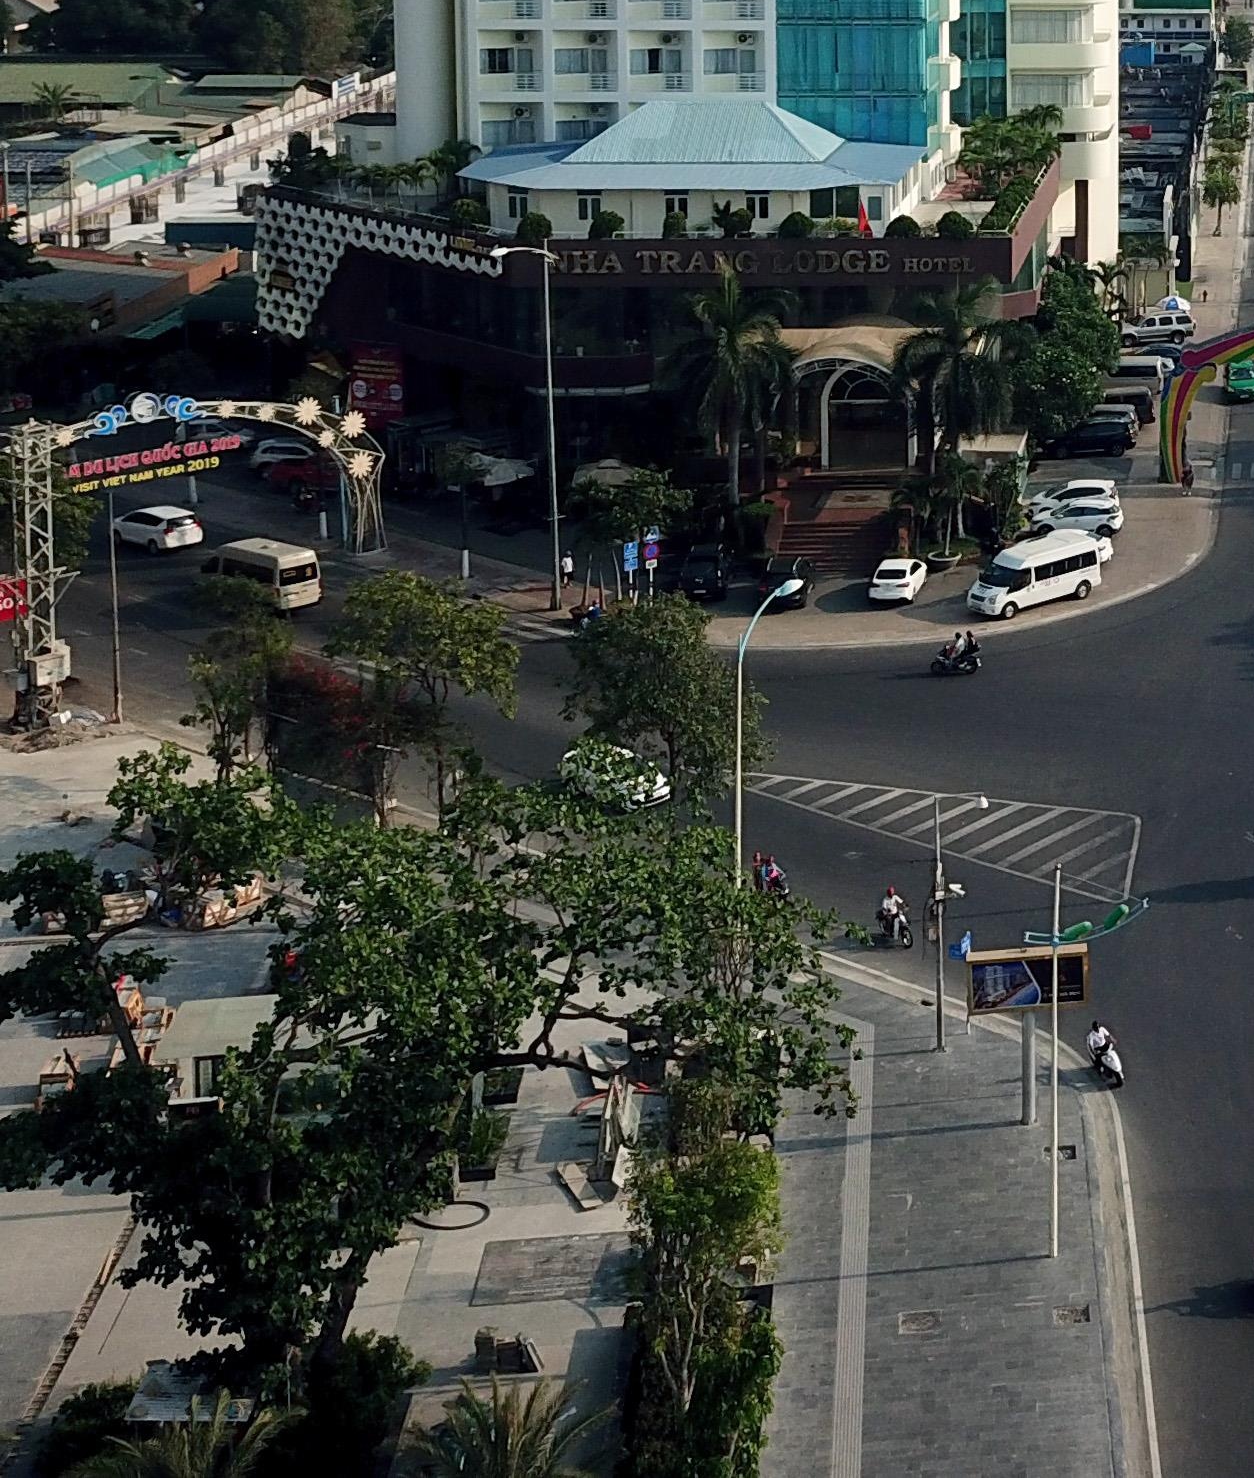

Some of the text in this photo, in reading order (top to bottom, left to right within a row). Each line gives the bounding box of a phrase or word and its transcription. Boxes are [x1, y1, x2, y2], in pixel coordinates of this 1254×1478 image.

[635, 249, 760, 275] TRANG
[771, 249, 891, 274] LODGE
[902, 257, 976, 274] HOTEL
[72, 480, 101, 495] VISIT
[129, 470, 155, 484] NAM
[156, 463, 185, 479] YEAR
[187, 456, 220, 473] 2019
